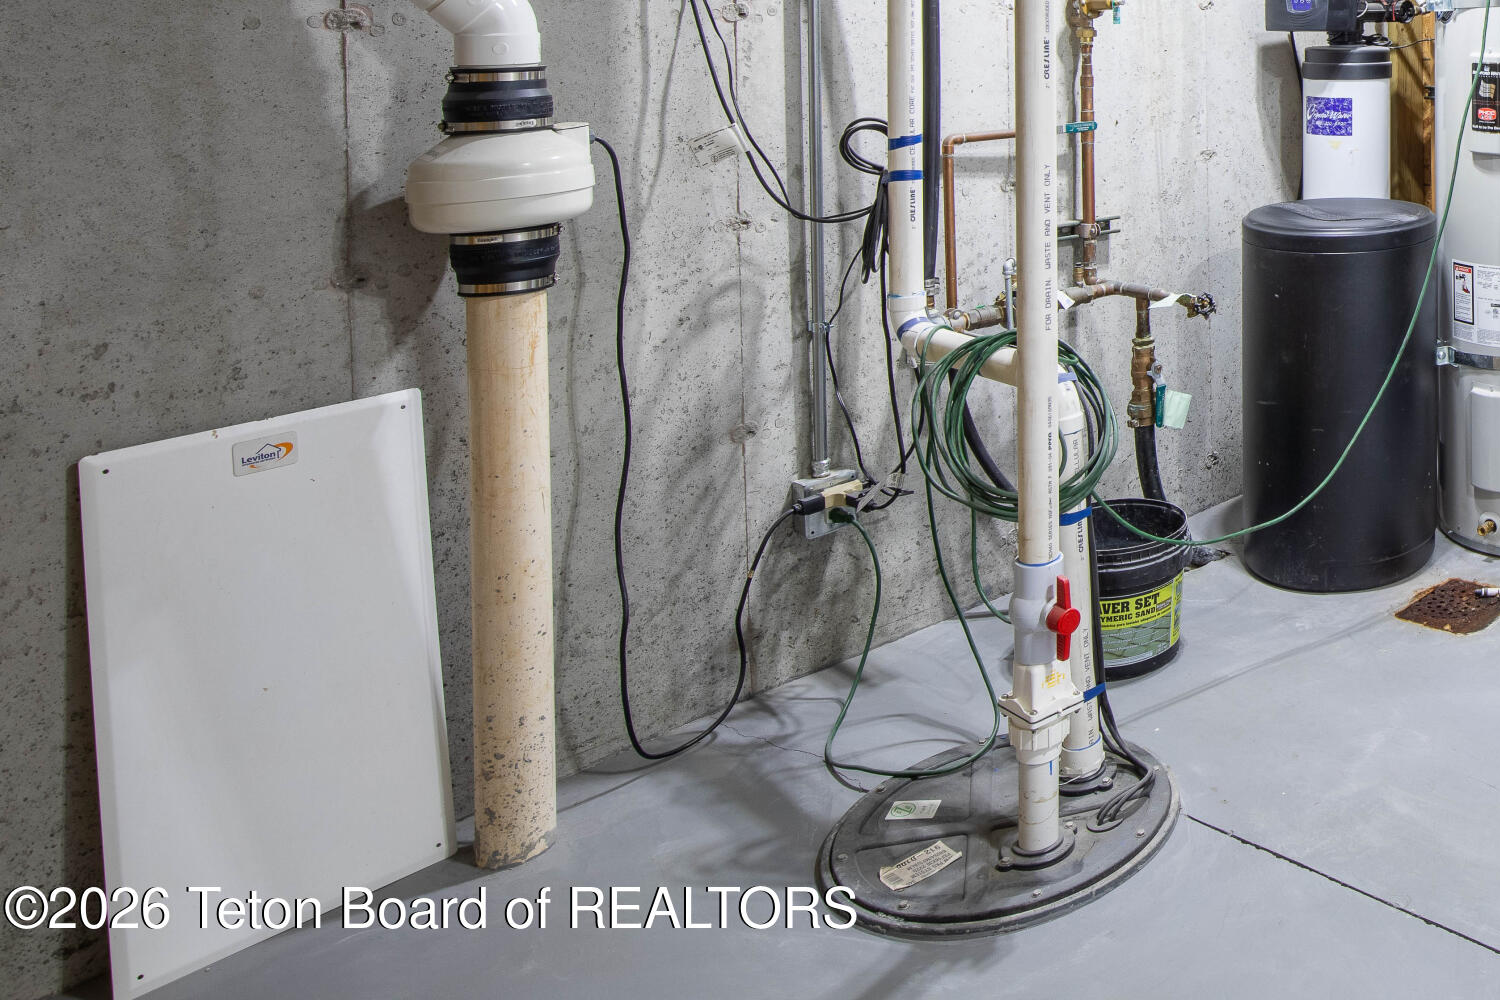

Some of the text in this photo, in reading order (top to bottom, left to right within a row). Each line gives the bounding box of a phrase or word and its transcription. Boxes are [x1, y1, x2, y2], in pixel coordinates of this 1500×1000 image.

[241, 452, 276, 464] Leviton
[1134, 592, 1160, 611] SET
[1100, 614, 1133, 623] YMERIC
[1135, 606, 1156, 619] SAND
